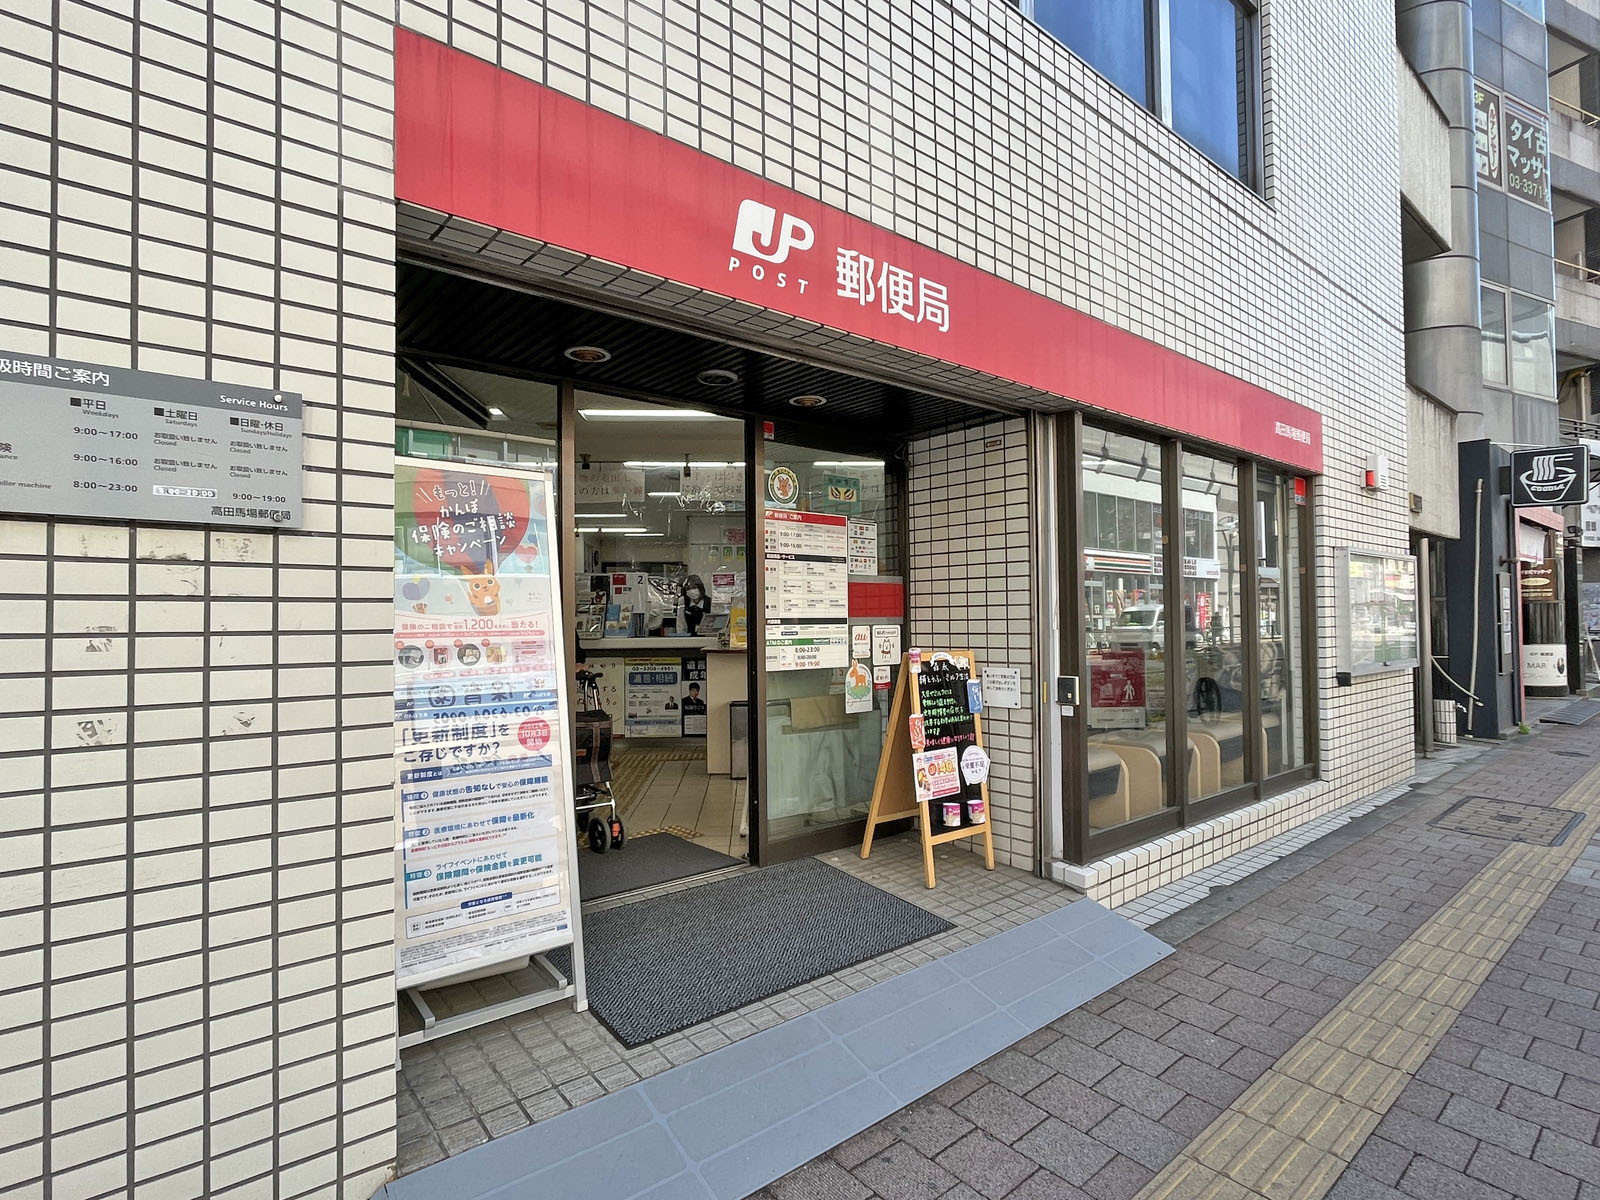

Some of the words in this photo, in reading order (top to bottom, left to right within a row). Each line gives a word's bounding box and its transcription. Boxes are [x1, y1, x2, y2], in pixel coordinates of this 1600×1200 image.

[729, 257, 809, 295] POST
[836, 246, 950, 333] 郵便局
[82, 398, 107, 410] 平日
[220, 394, 257, 408] Service
[259, 400, 288, 412] Hours
[82, 409, 119, 419] Weekdays
[165, 408, 198, 421] 土曜日
[165, 418, 198, 428] Saturdays
[240, 427, 292, 439] Sundays/Holidays
[18, 480, 52, 489] machine
[440, 499, 479, 518] かんぽ
[412, 512, 516, 544] 保険のご相談
[434, 536, 507, 557] キャンペーン
[638, 575, 644, 585] 2
